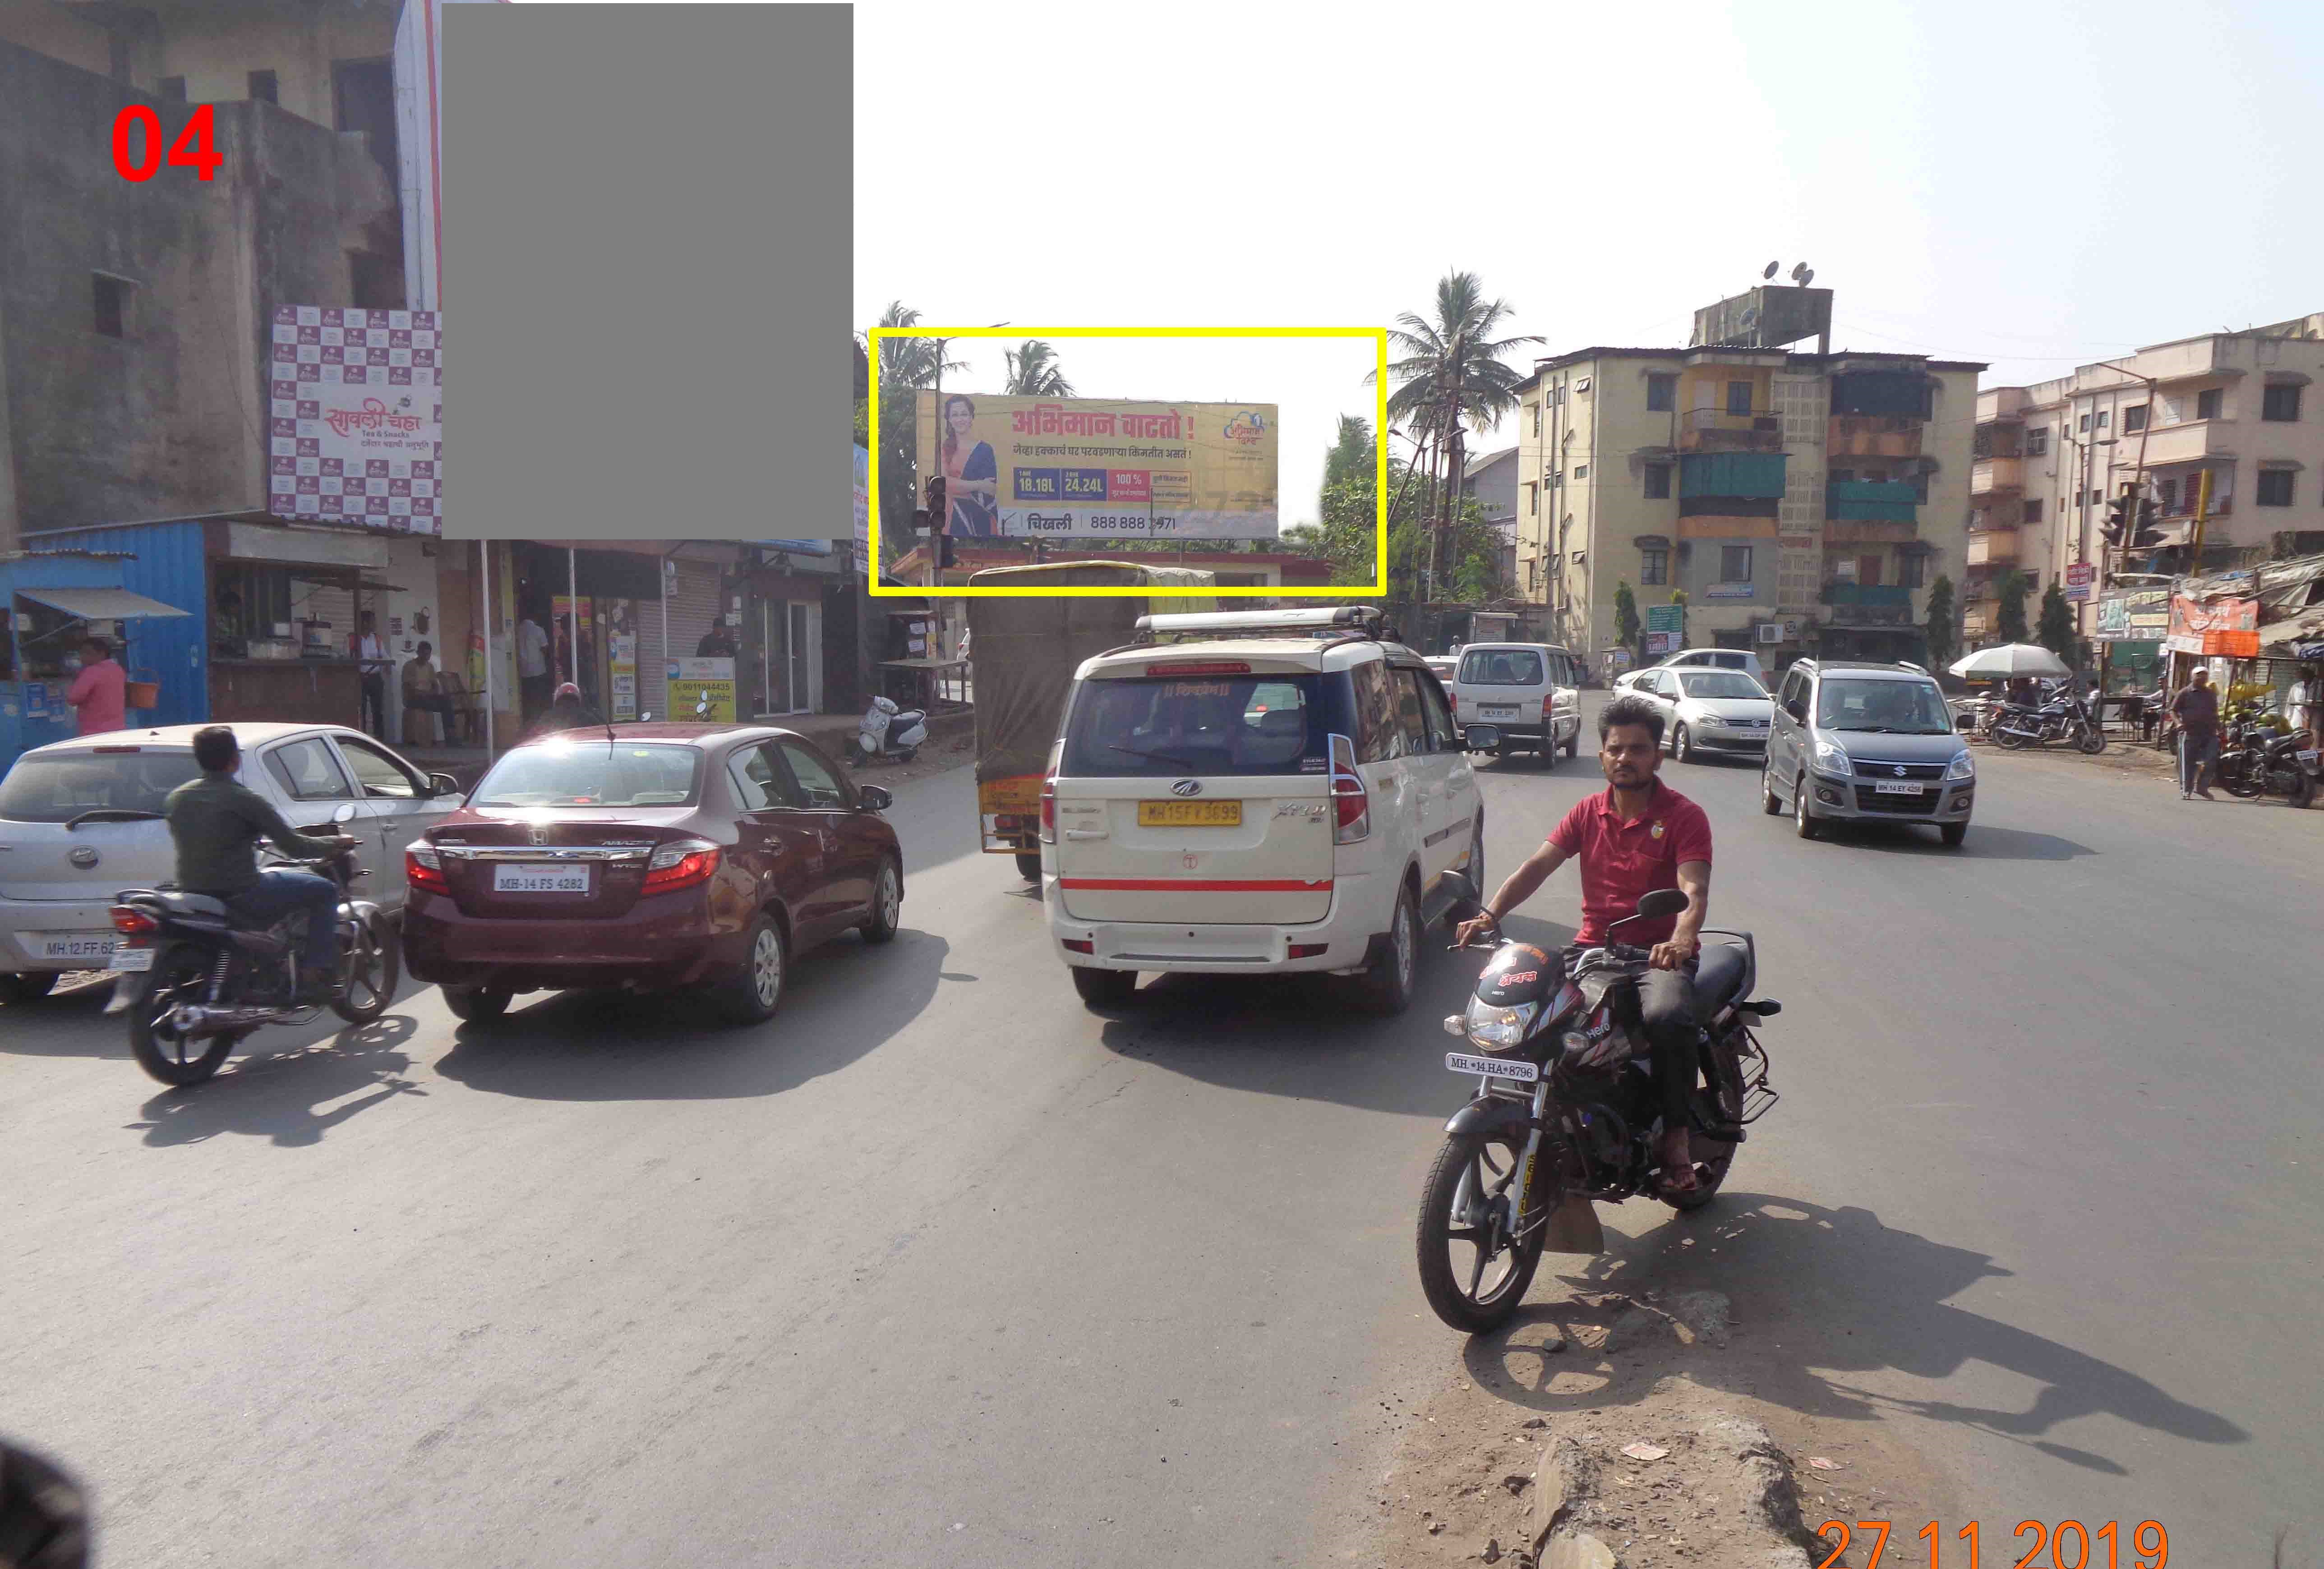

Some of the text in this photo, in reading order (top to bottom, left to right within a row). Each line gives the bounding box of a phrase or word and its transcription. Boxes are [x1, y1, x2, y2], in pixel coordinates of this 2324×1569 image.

[388, 415, 422, 431] चहा
[1013, 404, 1115, 437] अभिमान
[1122, 408, 1180, 439] वाटतो
[1068, 446, 1079, 456] घर
[1019, 478, 1103, 492] 18.18L 24.24L
[1116, 474, 1131, 484] 100
[1133, 475, 1142, 484] %
[1027, 513, 1072, 530] चिखली
[1091, 517, 1116, 529] 888
[1120, 517, 1144, 529] 888
[500, 878, 583, 889] MH-14 FS 4282
[47, 942, 115, 955] MH.12.FF.62
[1586, 1022, 1610, 1039] Hero
[1509, 1065, 1533, 1078] 8796
